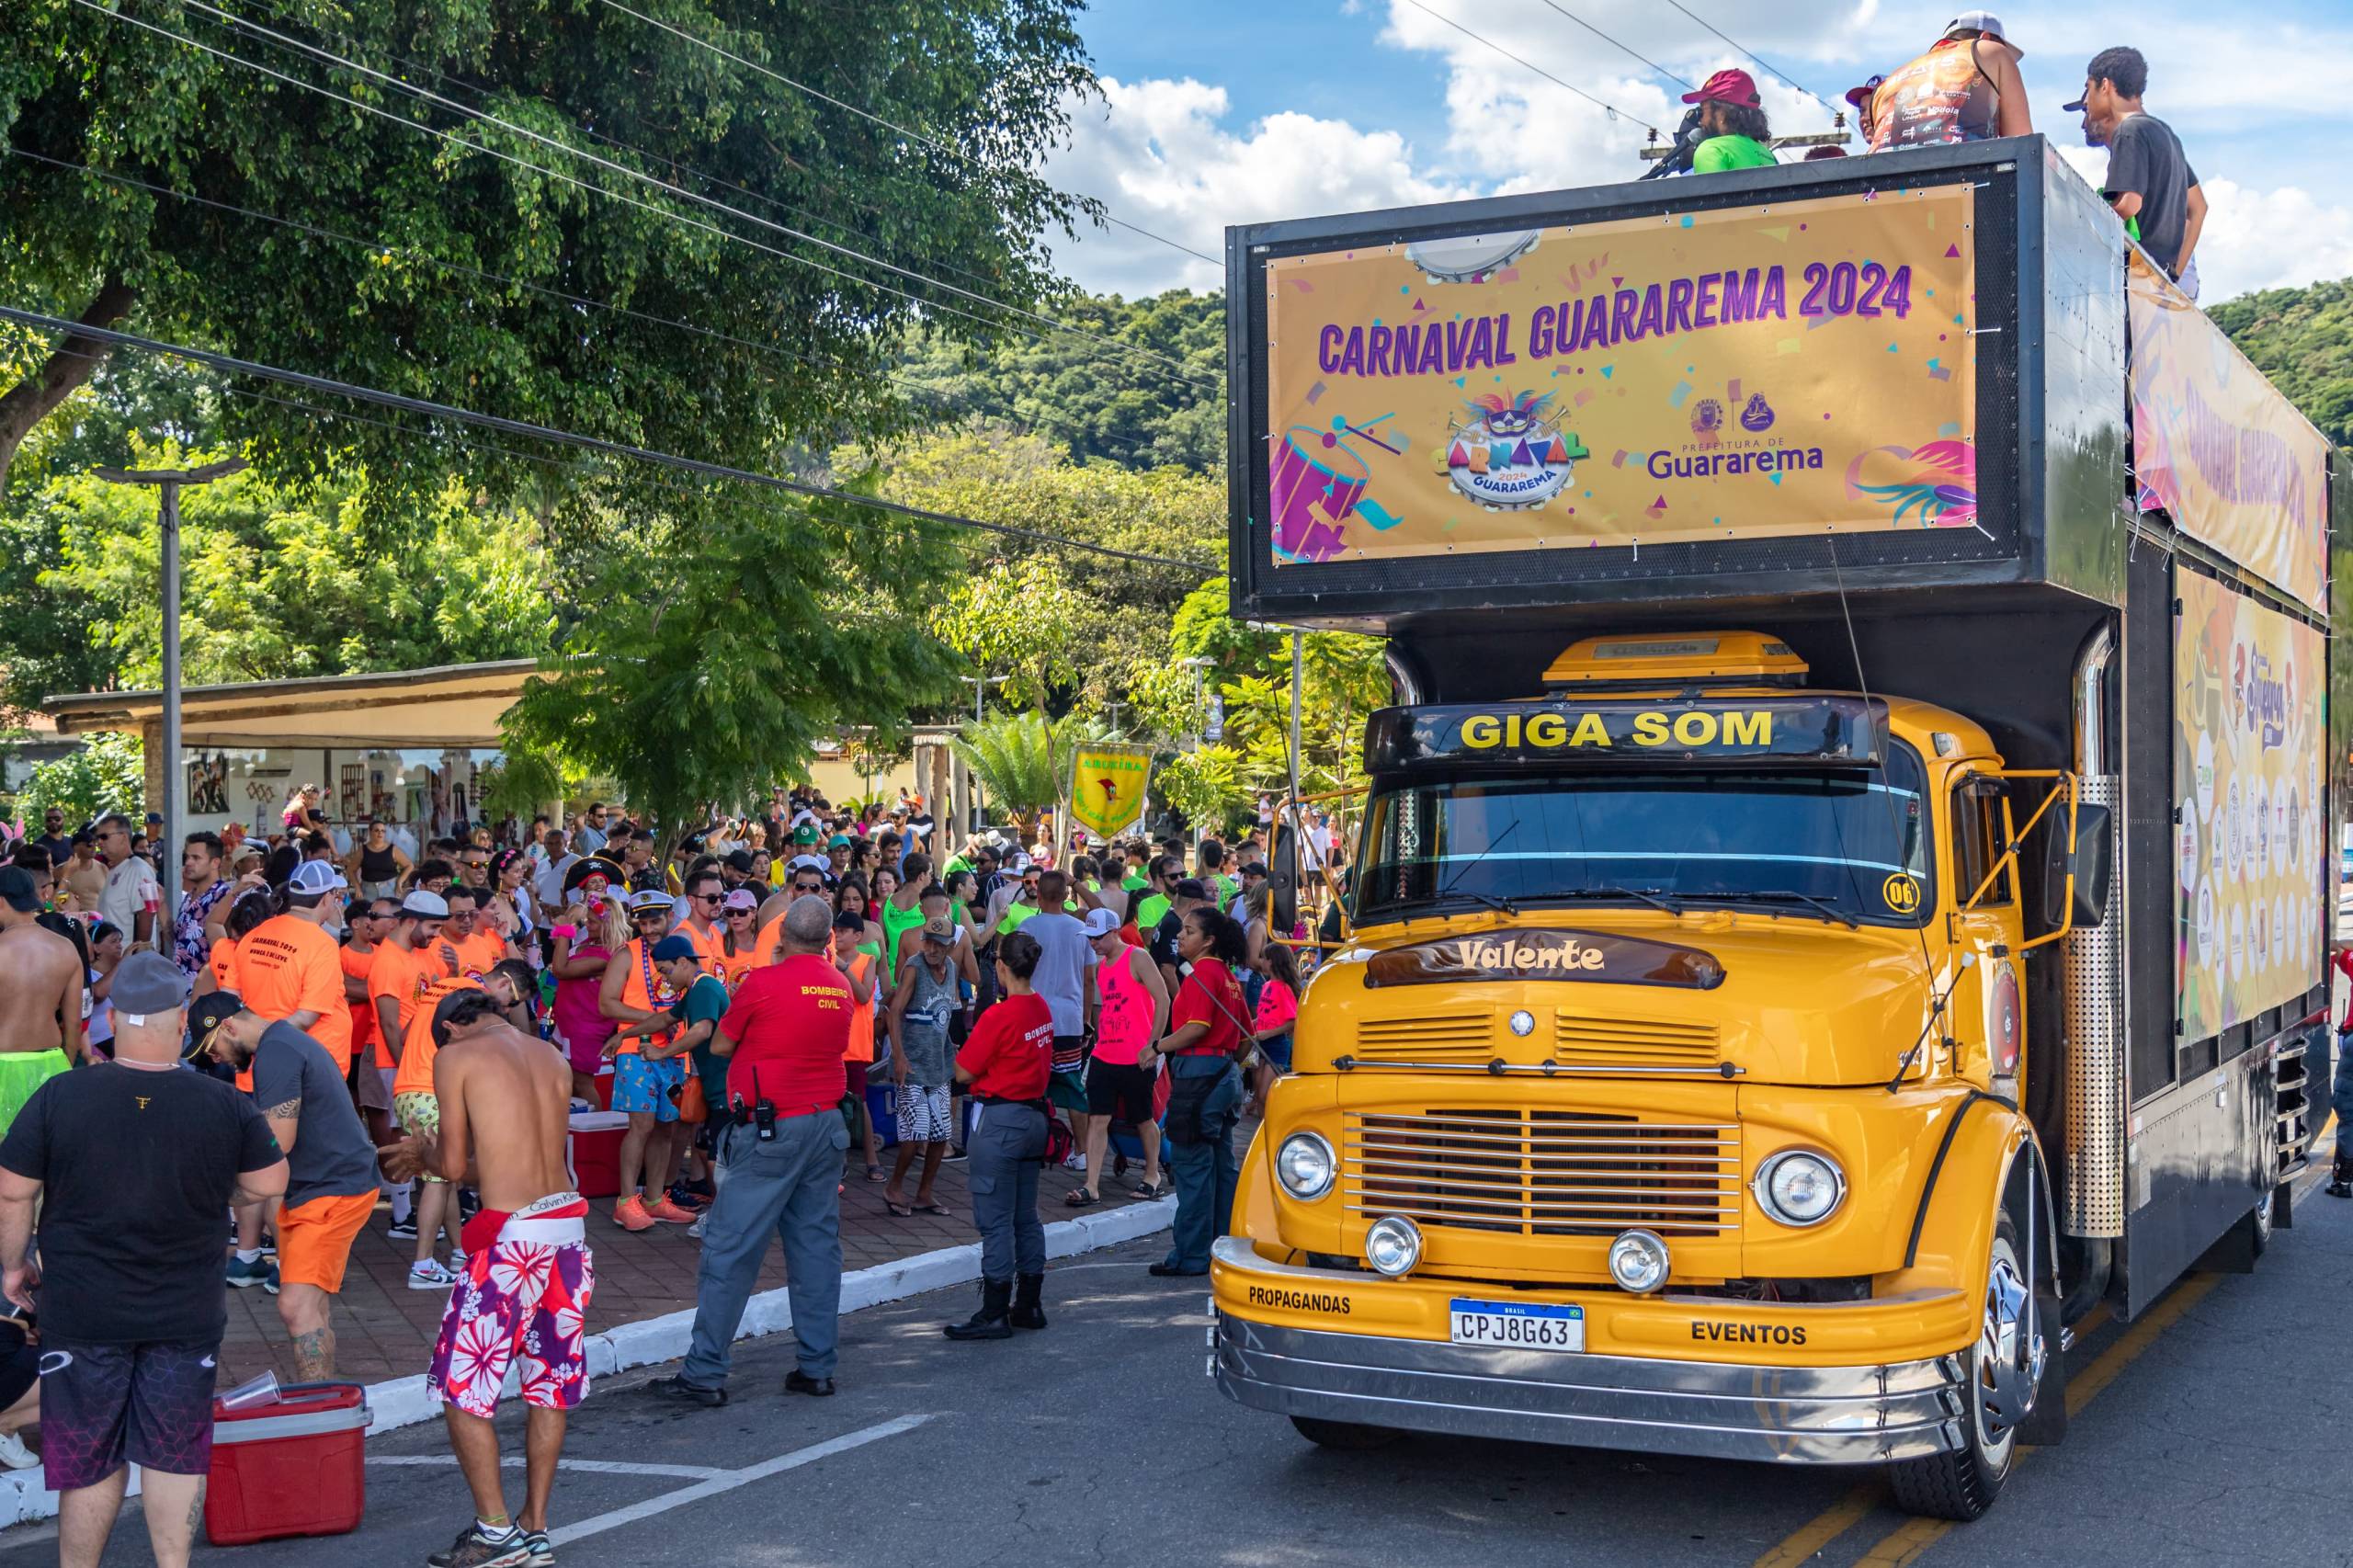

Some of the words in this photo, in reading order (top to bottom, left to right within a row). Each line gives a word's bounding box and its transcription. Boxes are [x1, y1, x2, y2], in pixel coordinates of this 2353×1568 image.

[1318, 313, 1517, 378] CARNAVAL
[1529, 265, 1788, 360] GUARAREMA
[1799, 261, 1913, 320] 2024
[1429, 432, 1591, 477] CARNAVAL
[1682, 438, 1760, 452] PREFEITURA
[1768, 437, 1785, 447] DE
[1647, 448, 1823, 479] Guararema
[1472, 470, 1557, 493] GUARAREMA
[1498, 472, 1528, 482] 2024
[1461, 713, 1612, 748] GIGA
[1631, 711, 1772, 746] SOM
[1889, 882, 1914, 904] 06
[1457, 939, 1605, 971] Valente
[801, 986, 848, 999] BOMBEIRO
[818, 999, 841, 1010] CIVIL
[1024, 1022, 1053, 1041] BOMBEIR
[529, 1198, 563, 1212] Calvin
[1249, 1286, 1350, 1314] PROPAGANDAS
[1505, 1307, 1526, 1315] BRASIL
[1461, 1314, 1568, 1346] CPJ8G63
[1691, 1321, 1807, 1346] EVENTOS
